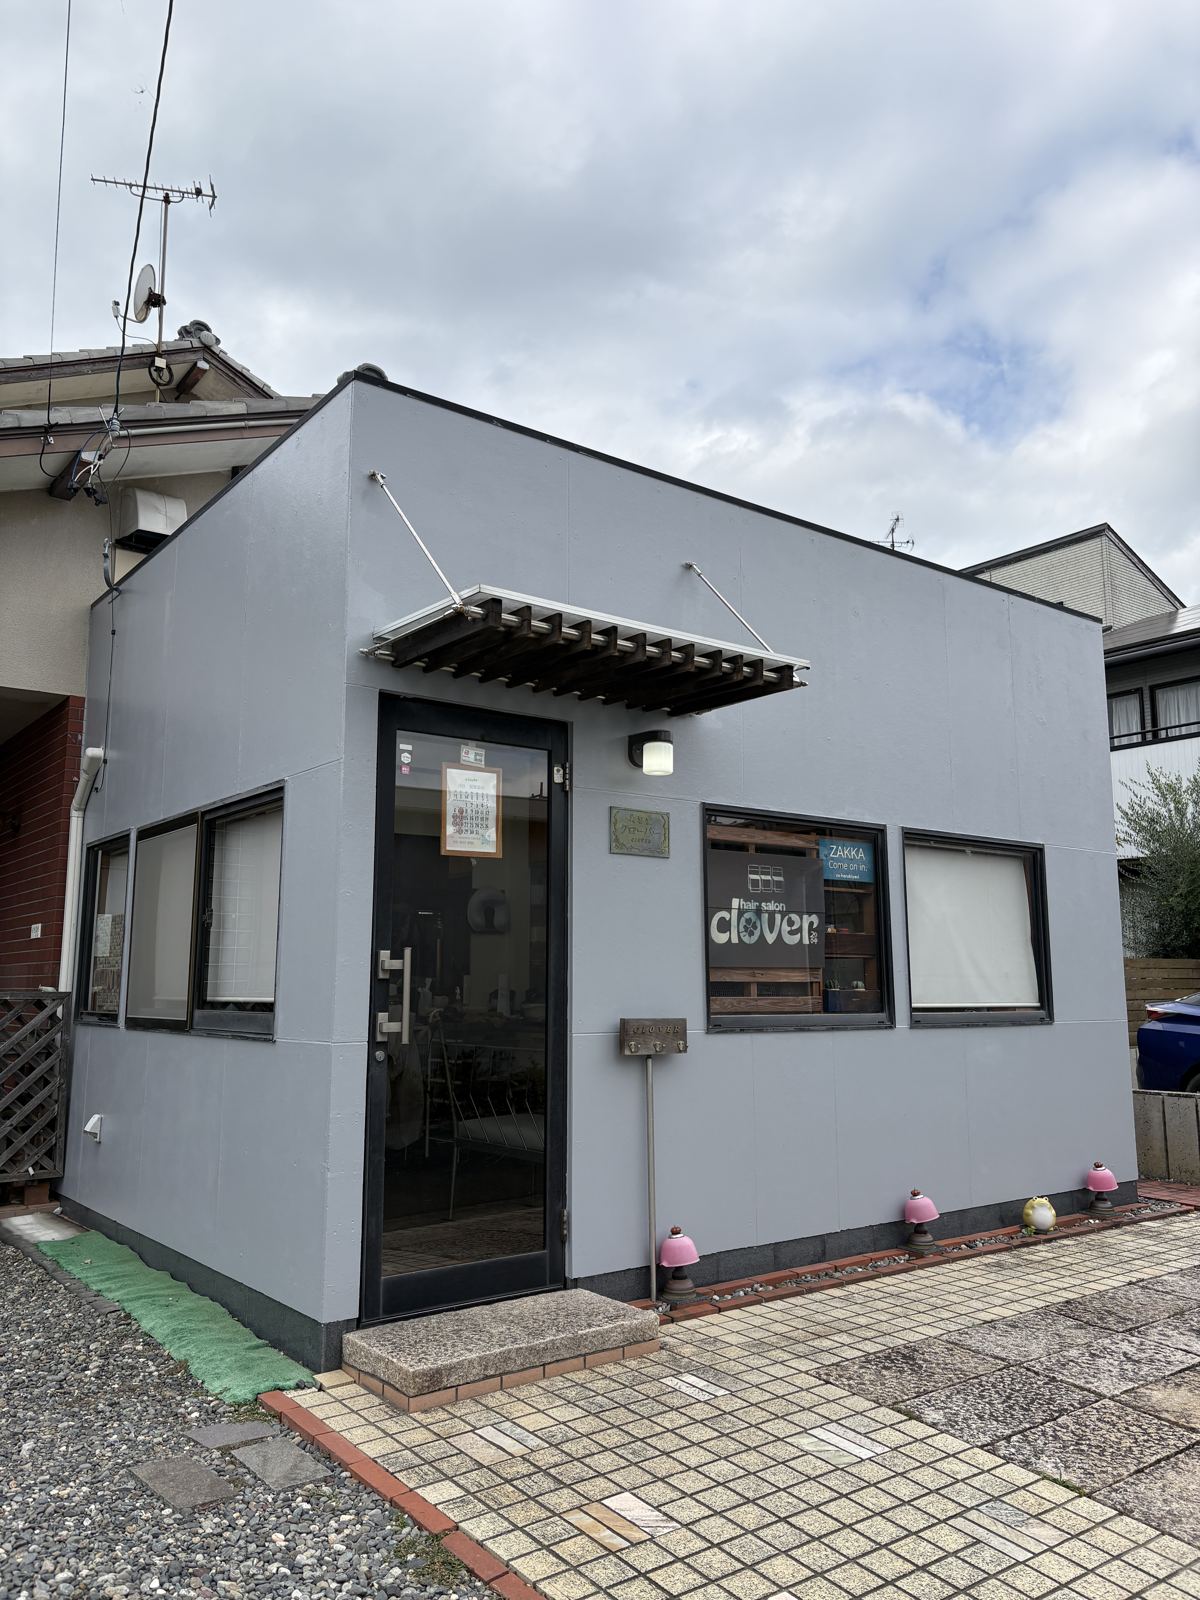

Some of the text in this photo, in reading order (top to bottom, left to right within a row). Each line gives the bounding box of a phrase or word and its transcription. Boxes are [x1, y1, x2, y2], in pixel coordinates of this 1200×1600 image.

[830, 845, 866, 860] ZAKKA
[829, 860, 849, 870] Come
[850, 863, 858, 871] on
[740, 898, 786, 912] hair salon
[710, 898, 819, 945] clover
